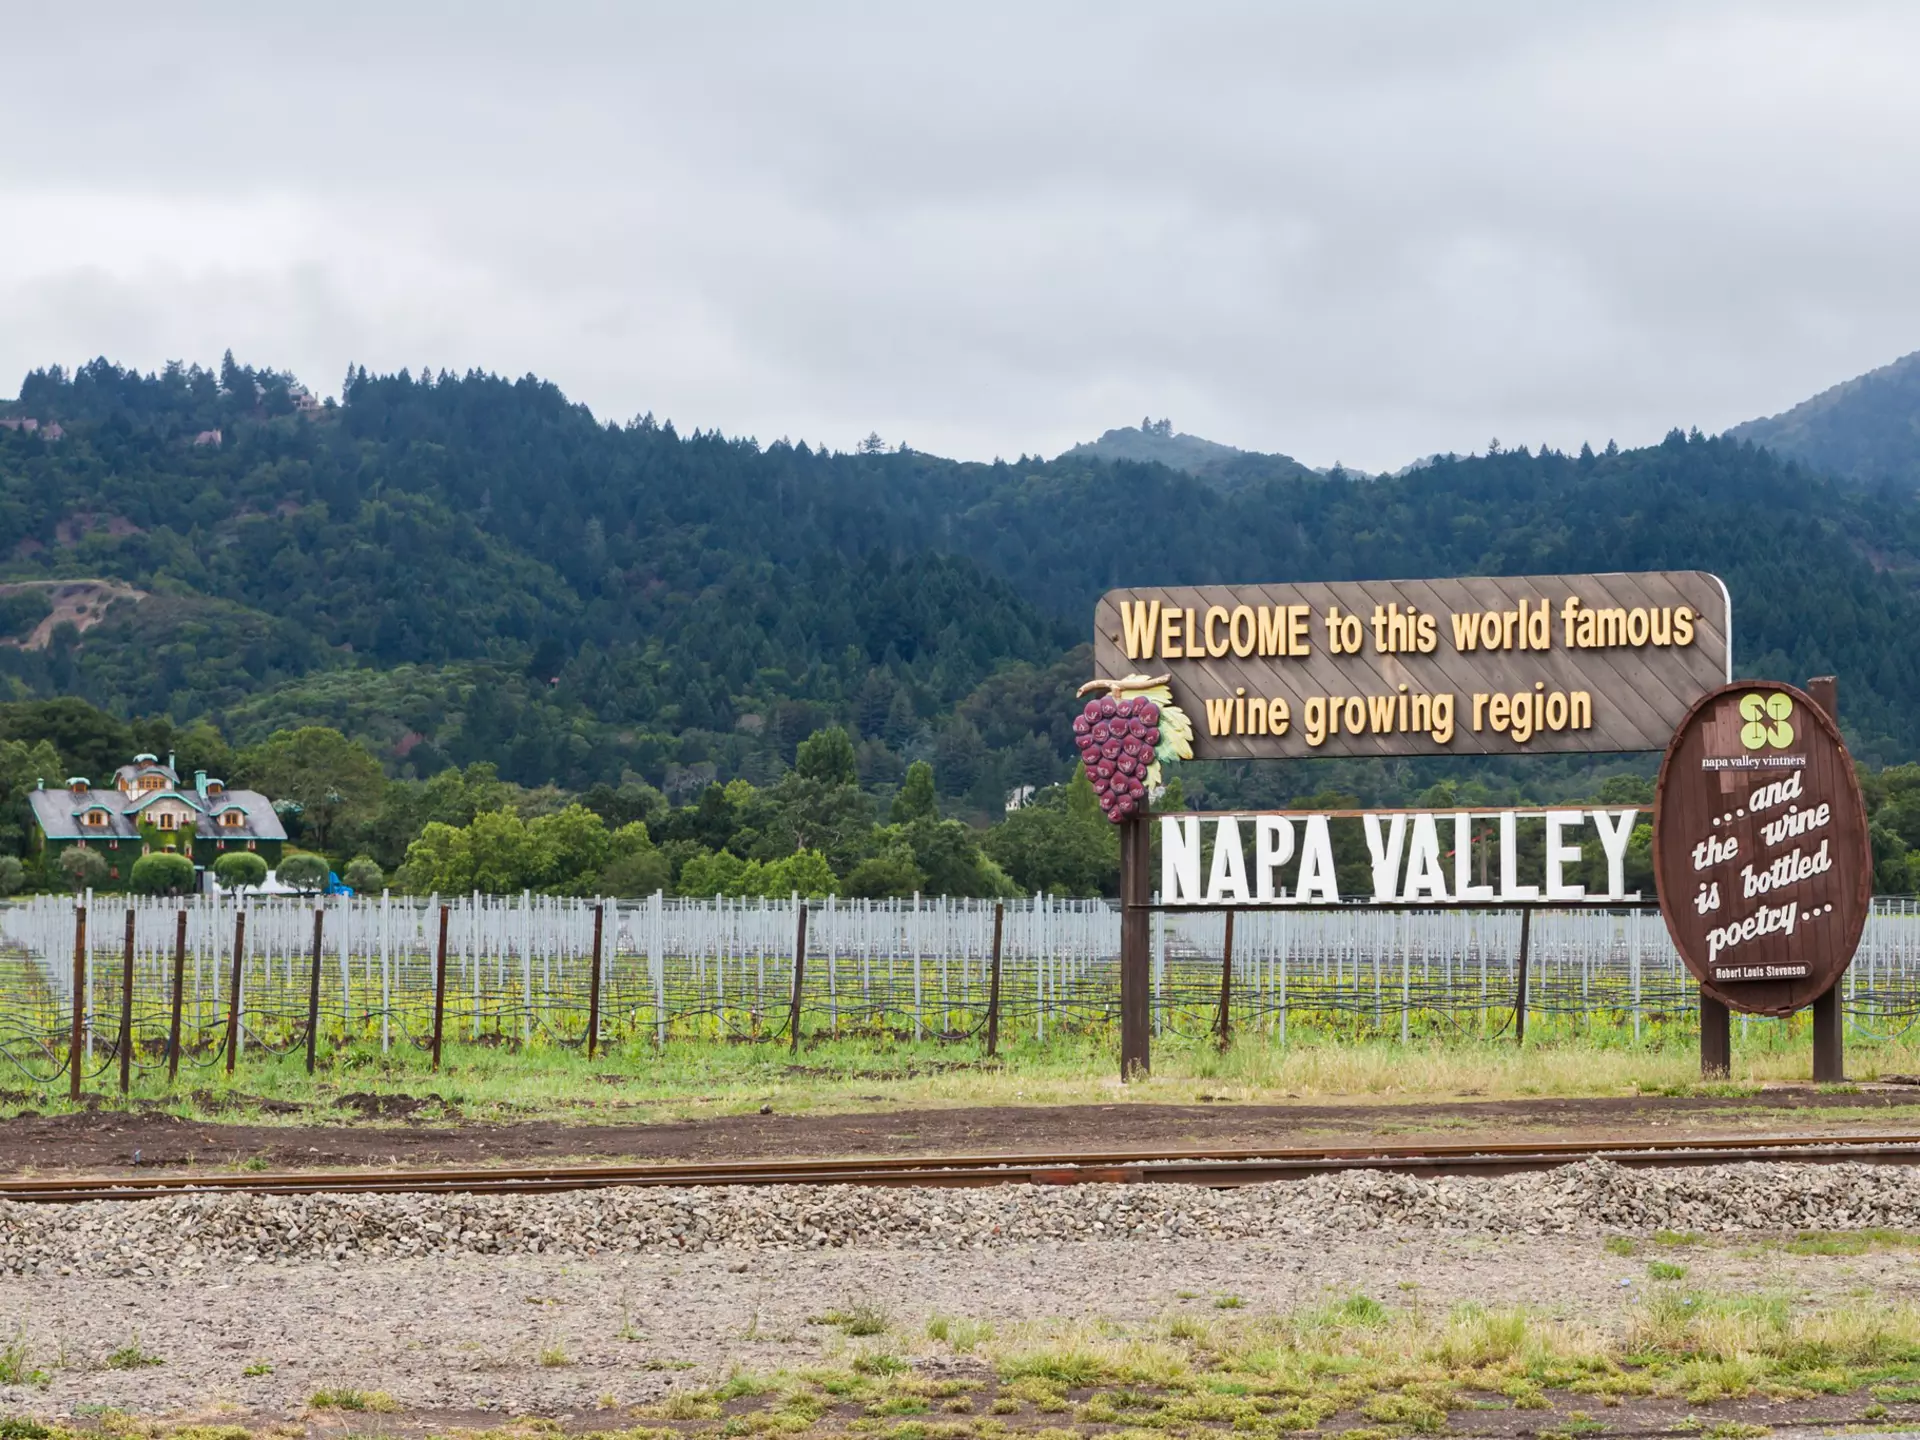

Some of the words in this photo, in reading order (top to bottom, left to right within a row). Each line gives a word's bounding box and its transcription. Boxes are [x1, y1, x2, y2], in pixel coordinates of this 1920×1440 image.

[1120, 600, 1310, 659] WELCOME
[1325, 607, 1363, 654] to
[1371, 603, 1437, 653] this
[1451, 598, 1550, 651] world
[1561, 597, 1694, 648] famous
[1206, 687, 1290, 736] wine
[1304, 683, 1454, 747] growing
[1473, 682, 1591, 743] region
[1702, 758, 1728, 769] napa
[1730, 755, 1761, 769] valley
[1762, 754, 1806, 768] vintners
[1161, 813, 1339, 904] NAPA
[1363, 809, 1639, 902] VALLEY
[1692, 835, 1739, 871] the
[1760, 802, 1830, 847] wine
[1694, 882, 1720, 914] is
[1741, 840, 1832, 898] bottled
[1716, 967, 1742, 979] Robert
[1743, 966, 1764, 978] Louis
[1766, 965, 1806, 977] Stevenson
